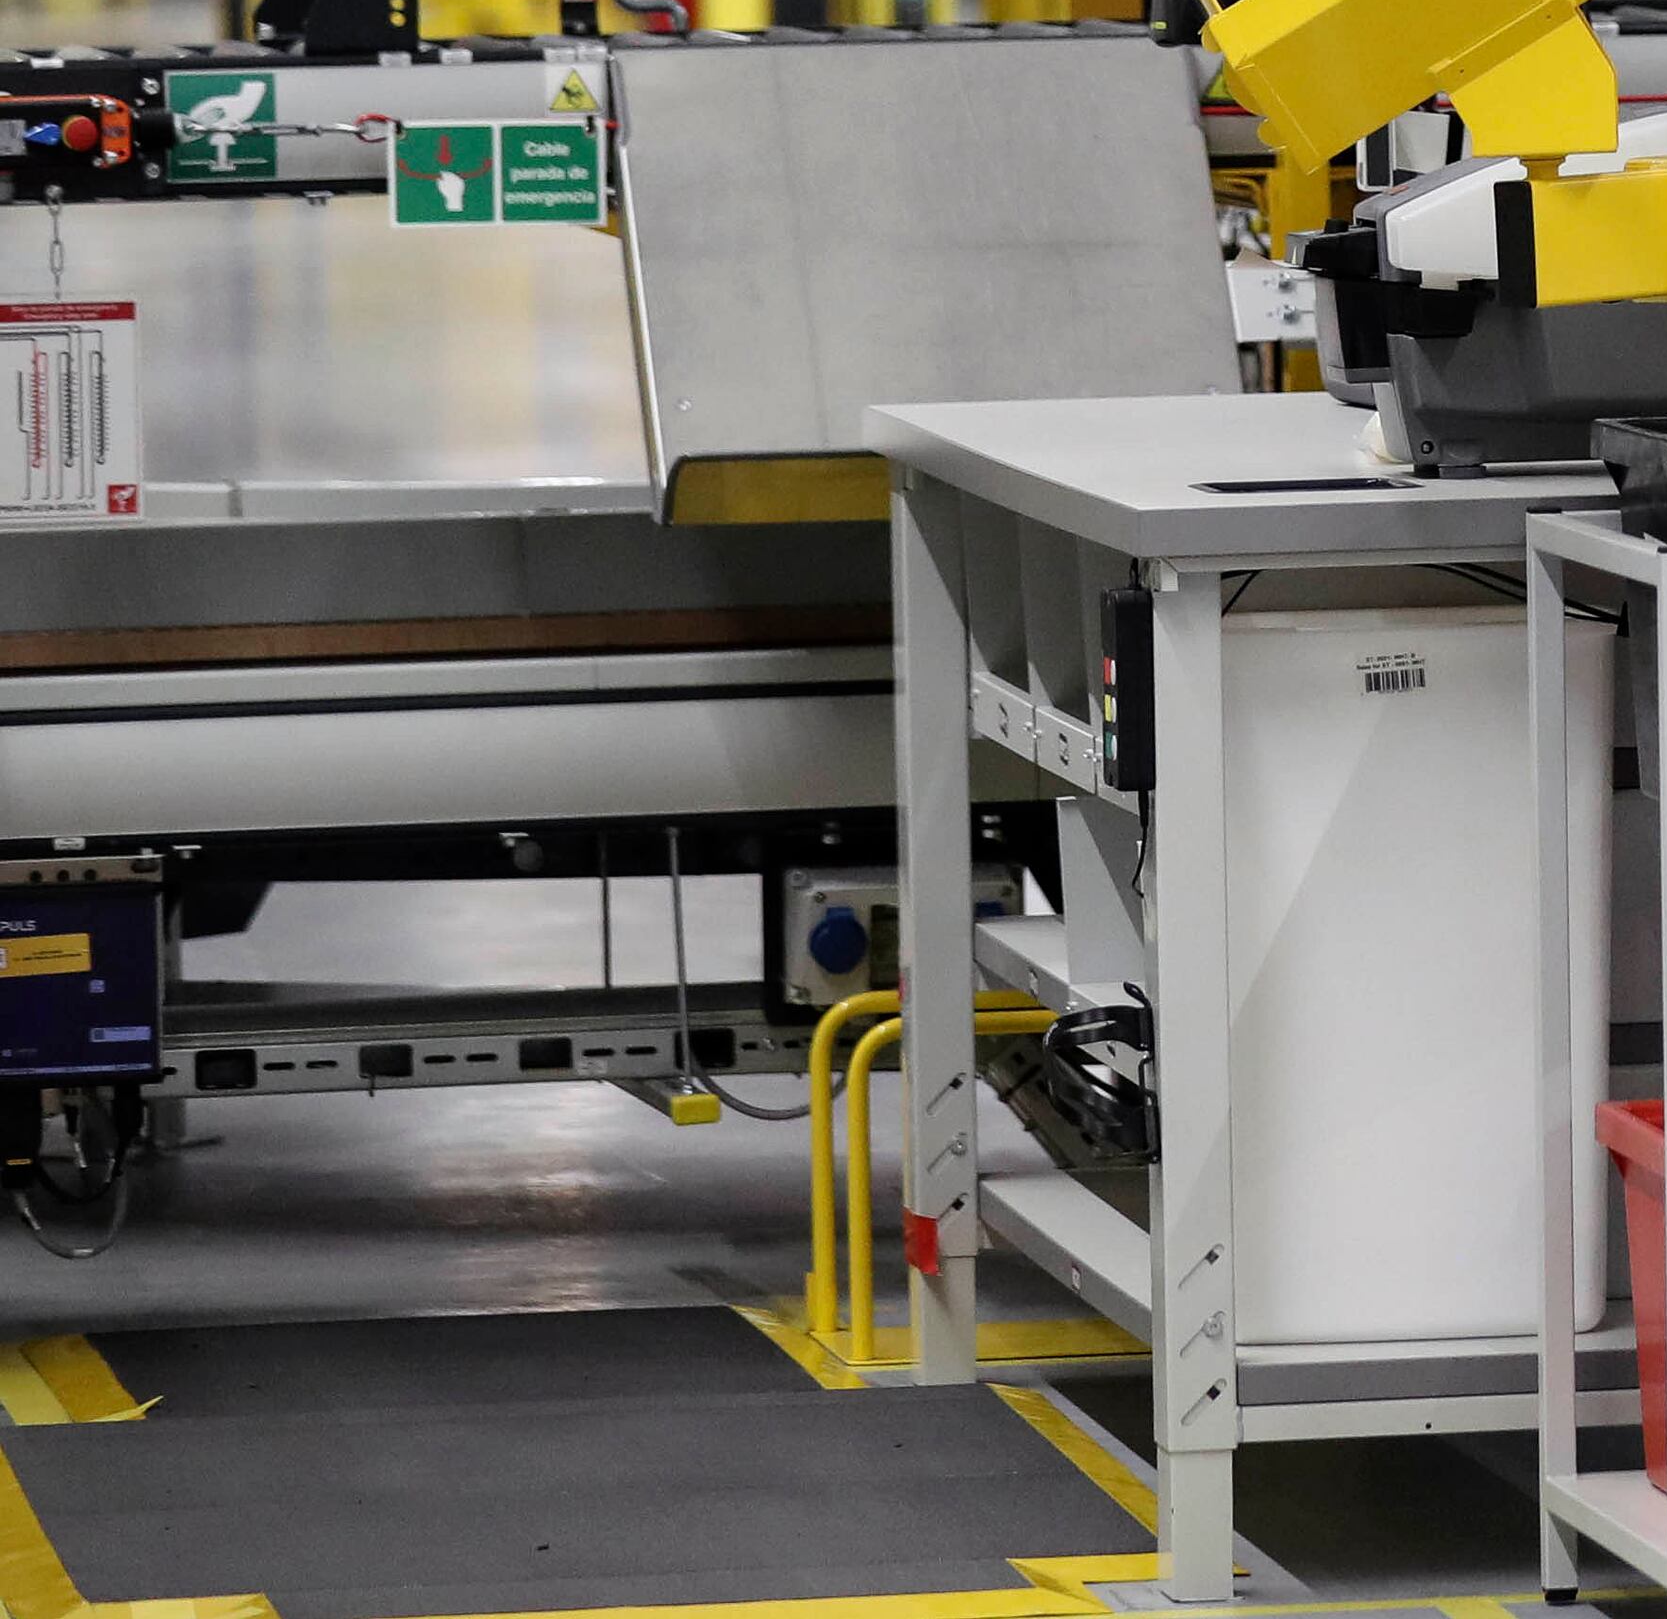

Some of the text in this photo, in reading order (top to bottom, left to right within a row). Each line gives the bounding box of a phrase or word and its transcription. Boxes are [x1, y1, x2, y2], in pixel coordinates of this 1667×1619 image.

[523, 140, 571, 158] Cable
[509, 165, 589, 183] parada de
[504, 189, 596, 207] emergencia
